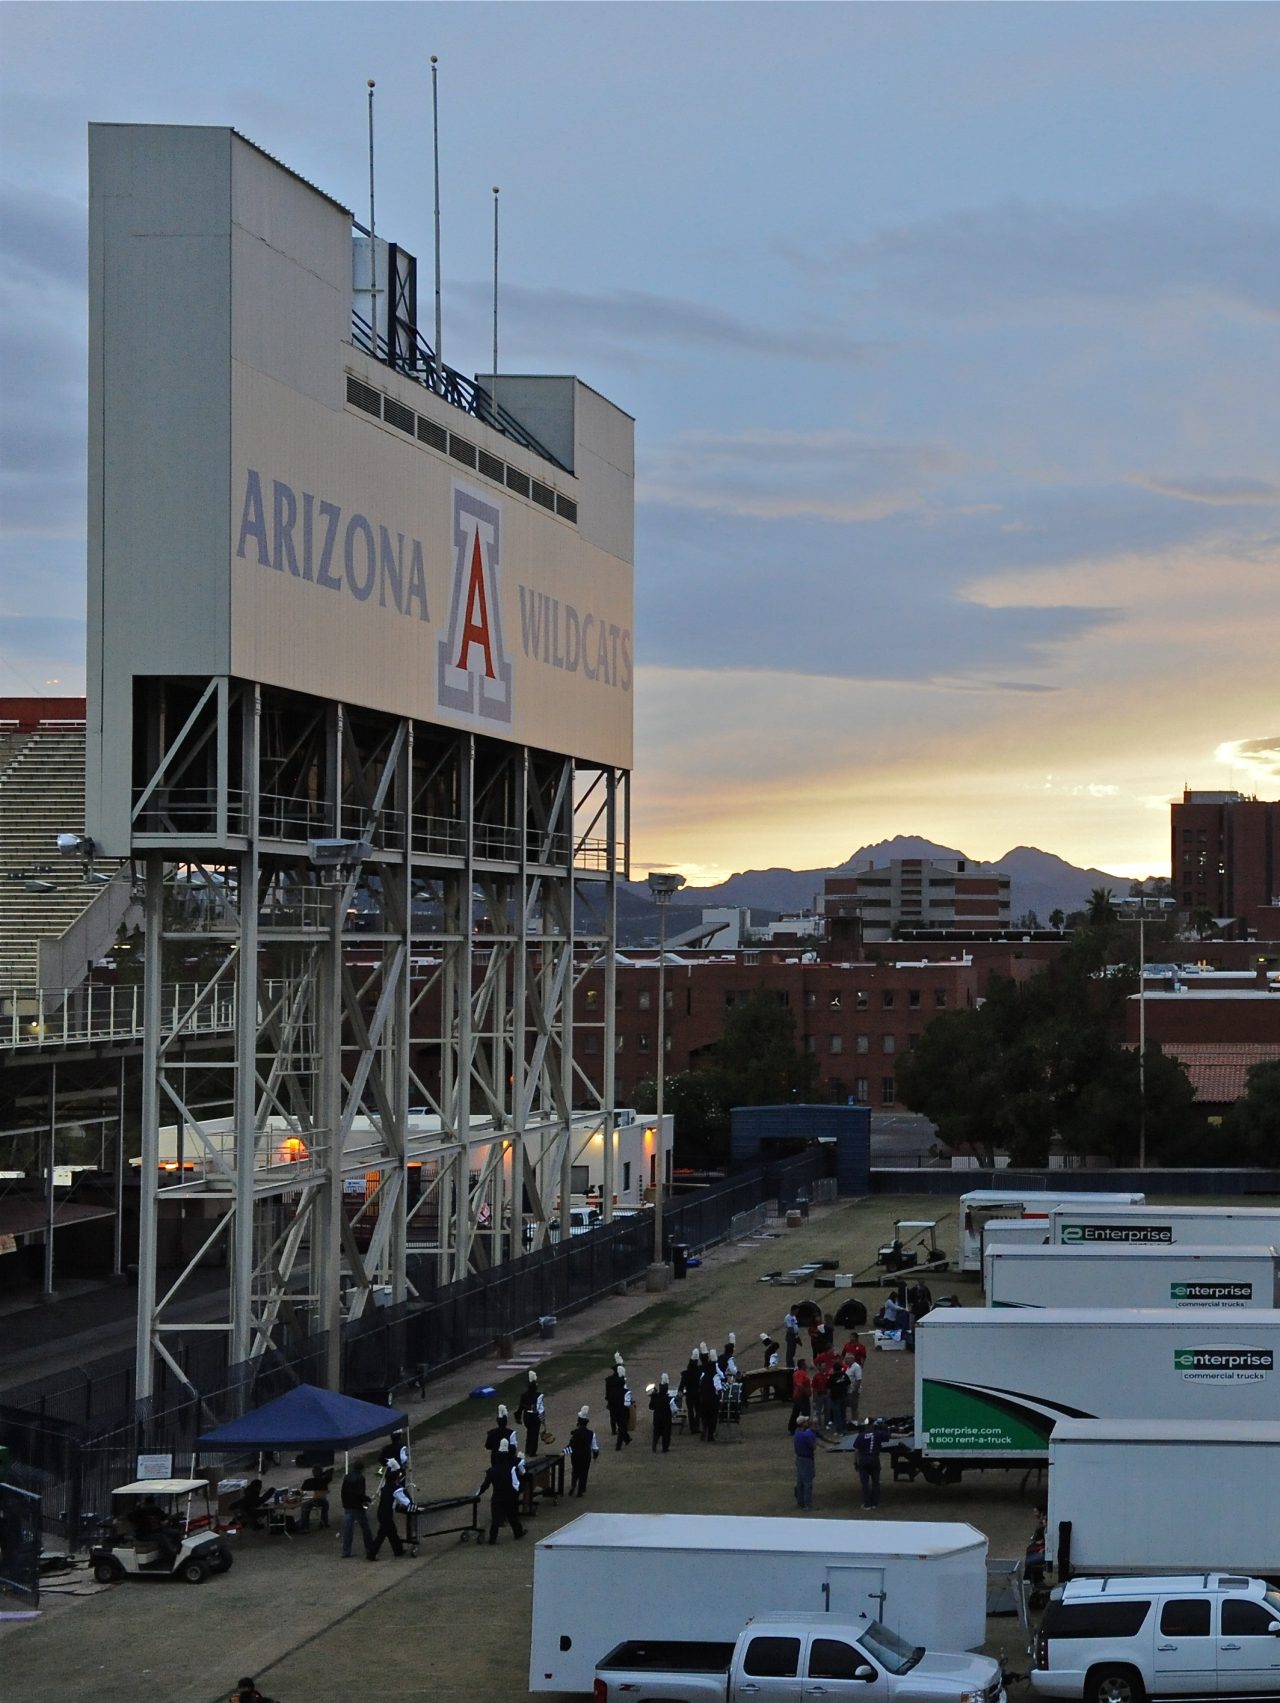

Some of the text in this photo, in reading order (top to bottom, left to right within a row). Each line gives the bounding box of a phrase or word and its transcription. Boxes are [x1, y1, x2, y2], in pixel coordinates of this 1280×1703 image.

[237, 468, 632, 731] ARIZONA A WILDCATS
[1085, 1227, 1171, 1243] Enterprise
[1172, 1285, 1251, 1298] enterprise
[1175, 1353, 1272, 1368] enterprise
[1184, 1372, 1235, 1380] commercial
[929, 1426, 1002, 1436] enterprise.com
[955, 1436, 1012, 1444] rent-a-truck
